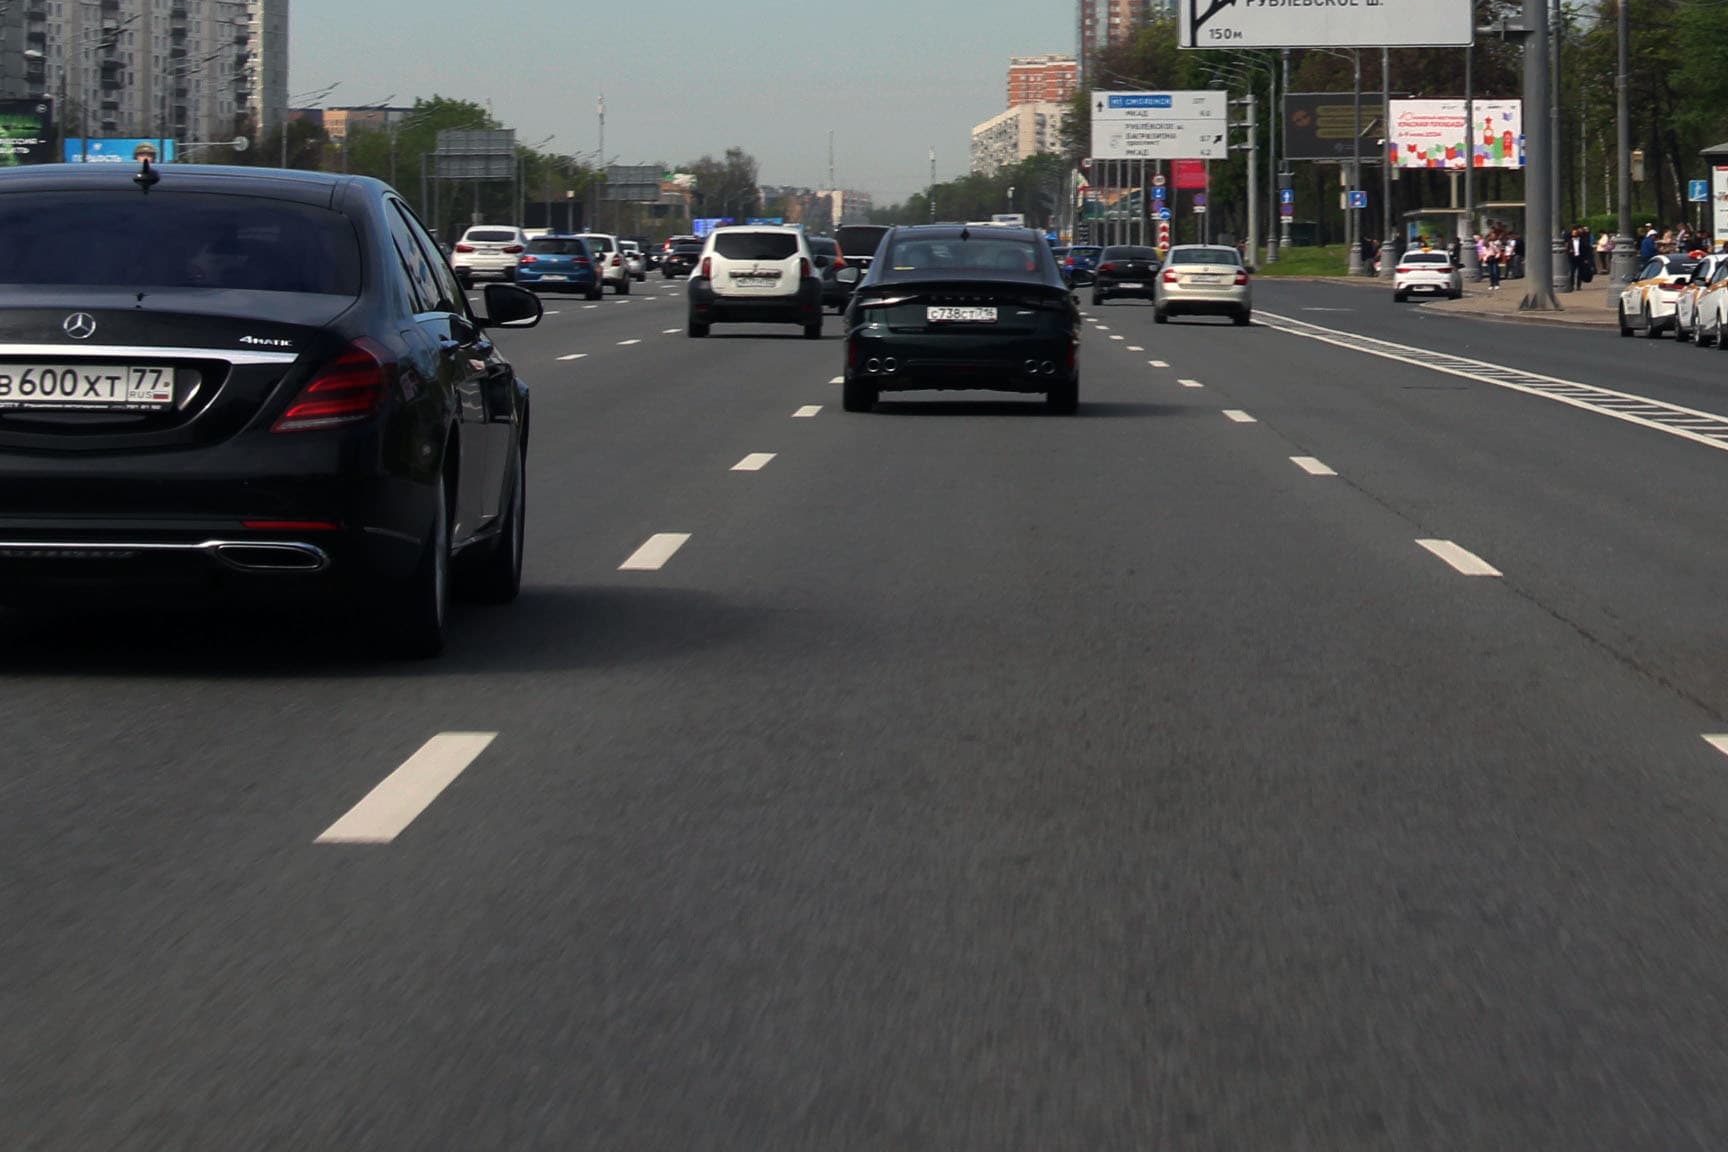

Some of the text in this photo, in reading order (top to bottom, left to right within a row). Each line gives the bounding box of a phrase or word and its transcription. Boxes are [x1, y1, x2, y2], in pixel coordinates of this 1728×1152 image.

[1209, 28, 1242, 39] 150м
[239, 335, 293, 346] 4MATIC
[132, 368, 164, 390] 77
[129, 391, 153, 399] RUS
